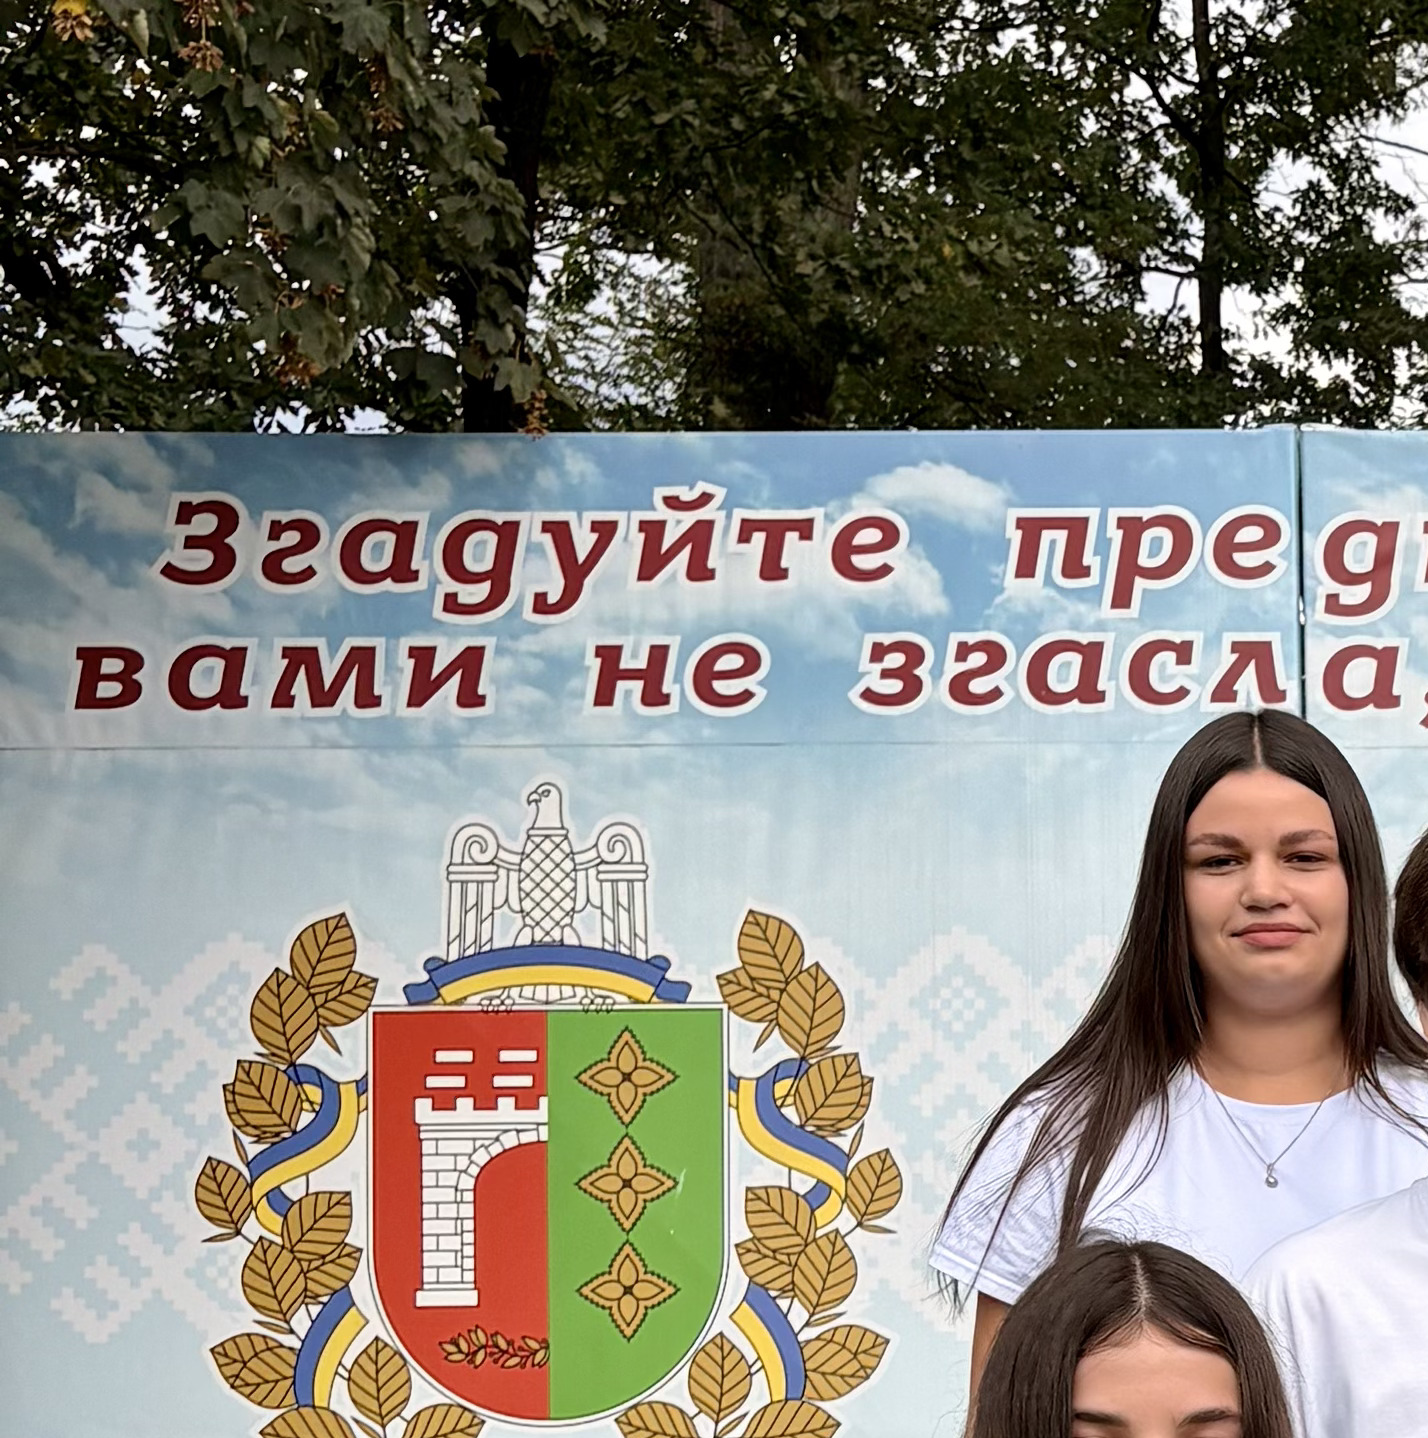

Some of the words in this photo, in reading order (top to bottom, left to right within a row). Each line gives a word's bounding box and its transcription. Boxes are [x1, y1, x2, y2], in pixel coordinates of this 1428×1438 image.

[162, 492, 900, 617] Згадуйте
[77, 645, 485, 711] вами
[593, 643, 761, 709] не
